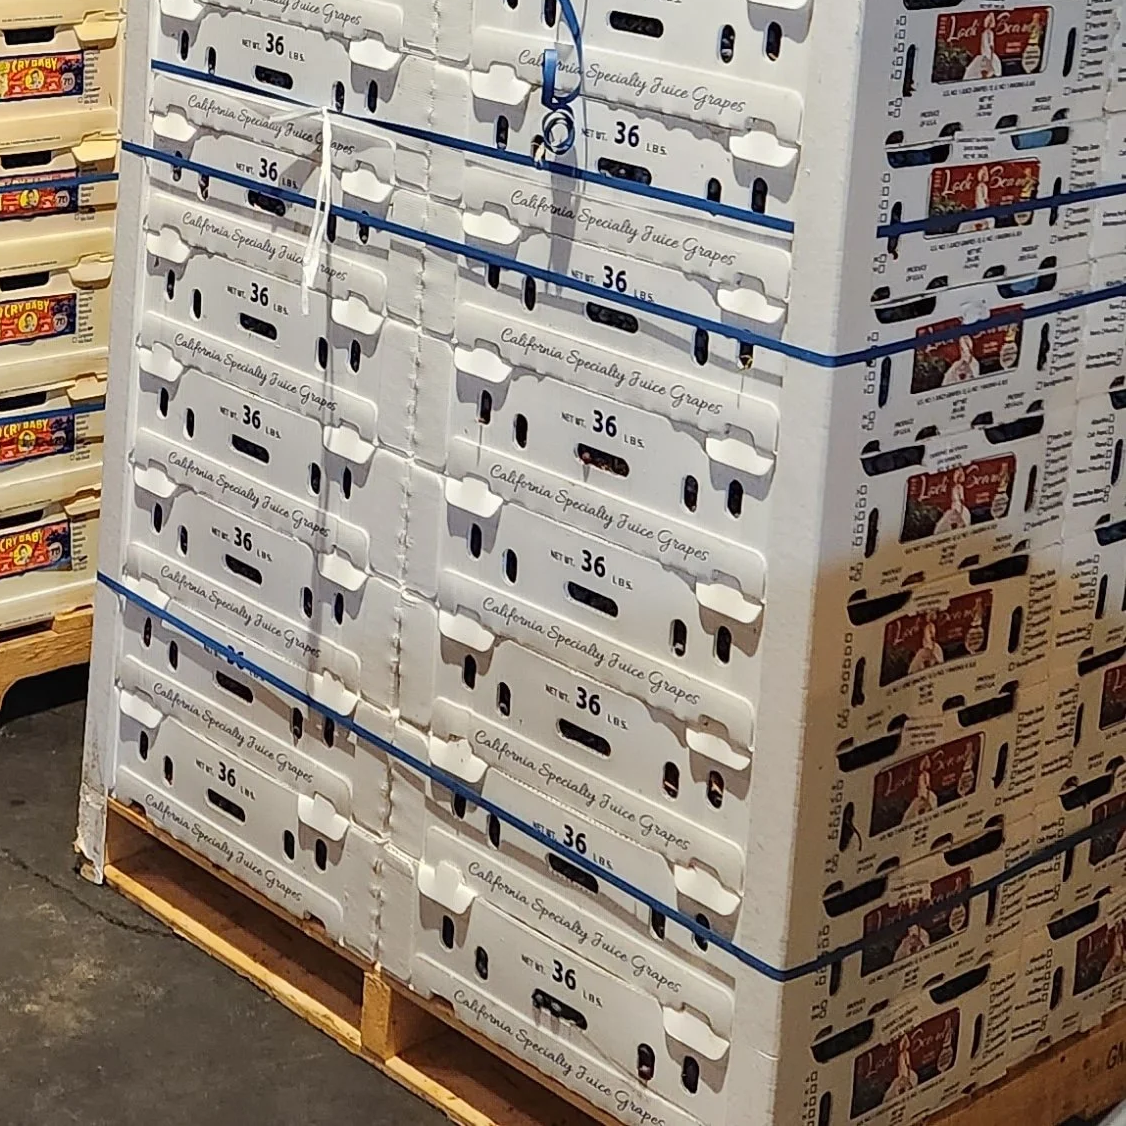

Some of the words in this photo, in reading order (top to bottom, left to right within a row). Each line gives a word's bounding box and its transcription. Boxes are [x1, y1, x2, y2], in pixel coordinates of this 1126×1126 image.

[322, 3, 362, 26] Grapes
[266, 32, 284, 56] 36
[12, 58, 30, 72] CRY
[31, 56, 58, 72] BABY
[511, 190, 575, 219] California
[578, 208, 638, 243] Specialty
[640, 225, 678, 250] Juice
[682, 237, 736, 266] Grapes
[4, 302, 22, 318] CRY
[24, 299, 50, 314] BABY
[174, 333, 222, 362] California
[223, 353, 268, 387] Specialty
[270, 372, 297, 396] Juice
[299, 384, 336, 412] Grapes
[501, 328, 563, 361] California
[565, 349, 626, 387] Specialty
[626, 370, 666, 396] Juice
[669, 383, 723, 415] Grapes
[4, 422, 22, 438] CRY
[22, 418, 48, 433] BABY
[242, 405, 262, 429] 36
[592, 410, 618, 438] 36
[168, 452, 214, 482] California
[215, 474, 260, 508] Specialty
[262, 495, 290, 519] Juice
[291, 509, 330, 538] Grapes
[490, 464, 553, 500] California
[554, 489, 614, 529] Specialty
[616, 512, 654, 540] Juice
[657, 529, 710, 562] Grapes
[18, 529, 44, 546] BABY
[580, 549, 606, 578] 36
[576, 686, 601, 716] 36
[474, 729, 536, 771] California
[538, 764, 596, 806] Specialty
[598, 792, 636, 822] Juice
[638, 814, 691, 852] Grapes
